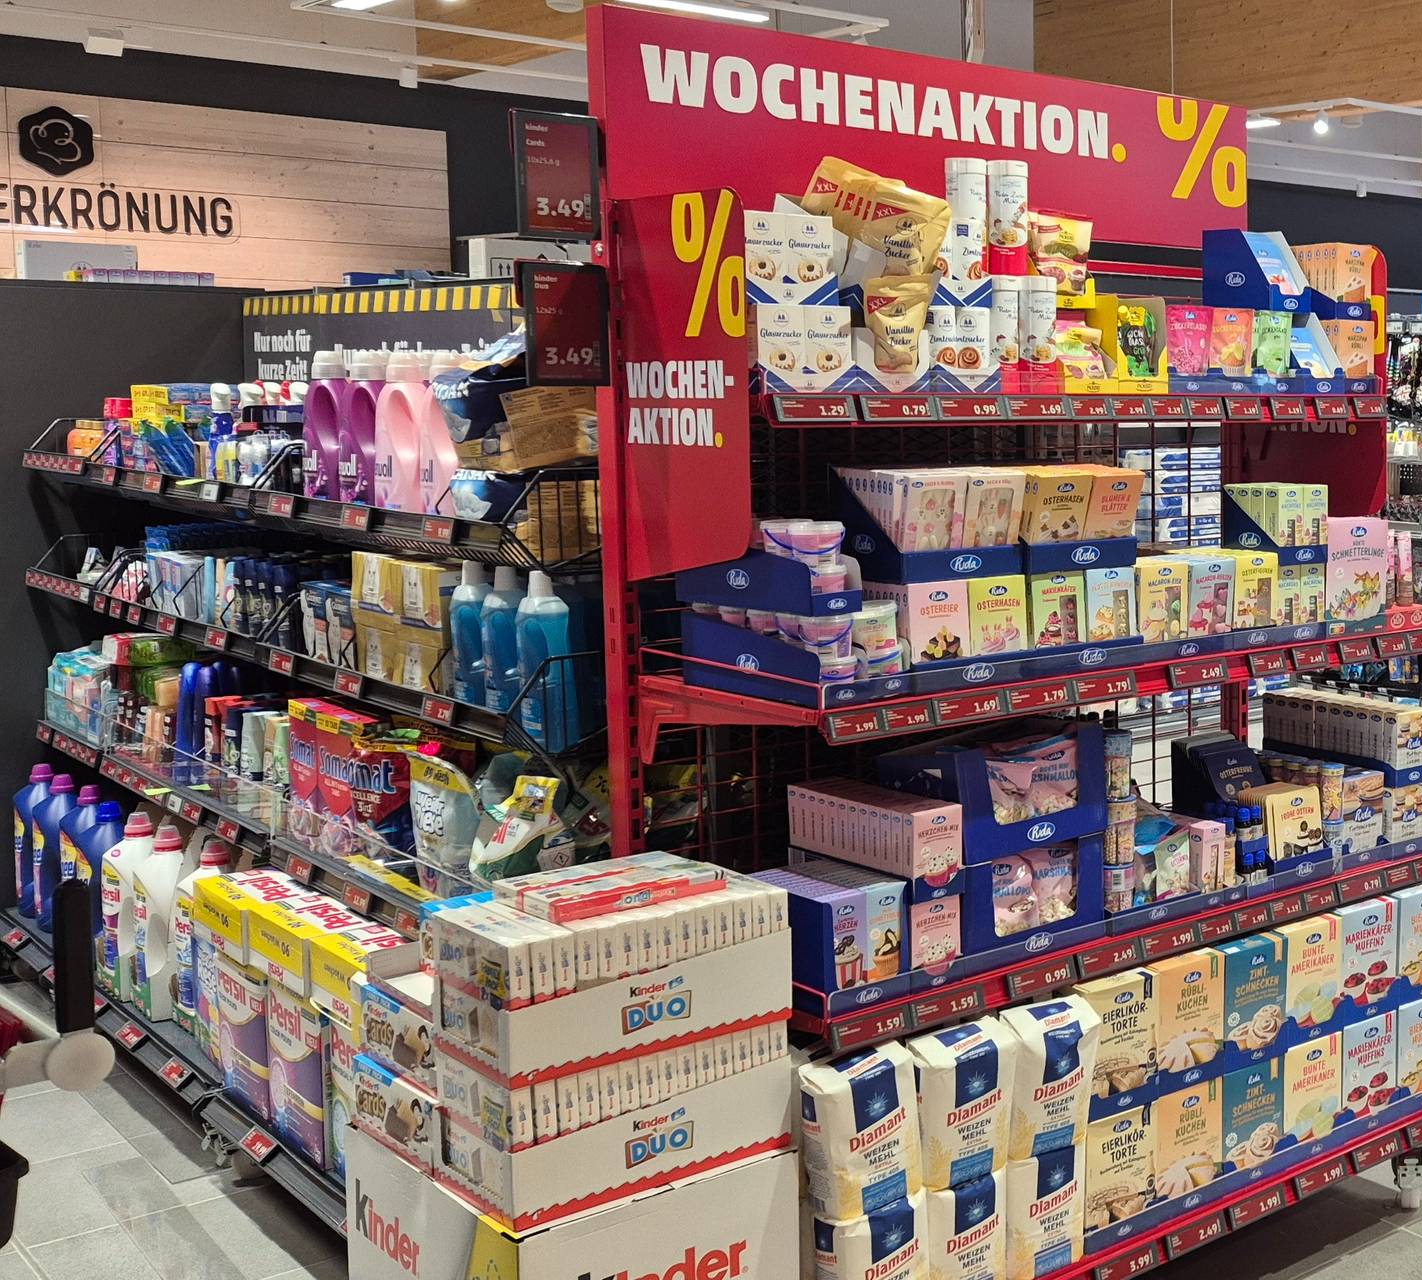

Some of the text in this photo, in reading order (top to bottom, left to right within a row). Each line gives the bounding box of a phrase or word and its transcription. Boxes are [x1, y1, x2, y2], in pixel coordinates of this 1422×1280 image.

[640, 43, 1248, 208] WOCHENAKTION. %
[816, 181, 837, 193] XXL
[536, 197, 584, 217] 3.49
[876, 205, 896, 216] XXL
[788, 239, 832, 250] Glasurzucker
[671, 188, 746, 338] %
[868, 298, 888, 309] XXL
[760, 328, 802, 339] Glasurzucker
[807, 329, 849, 340] Glasurzucker
[885, 324, 915, 336] Vanillin
[254, 331, 270, 352] Nur
[271, 329, 294, 352] noch
[295, 328, 312, 352] für
[545, 346, 594, 366] 3.49
[258, 355, 308, 382] kurze Zeit!
[626, 359, 735, 399] WOCHEN-
[820, 405, 844, 416] 1.29
[902, 405, 926, 416] 0.79
[973, 404, 996, 415] 0.99
[1040, 404, 1061, 415] 1.69
[627, 407, 724, 448] AKTION.
[1331, 548, 1385, 561] SCHMETTERLINGE
[920, 604, 960, 616] OSTEREIER
[976, 598, 1021, 611] OSTERHASEN
[1202, 667, 1221, 679] 2.49
[1107, 680, 1127, 693] 1.79
[1043, 689, 1064, 702] 1.79
[974, 700, 996, 713] 1.69
[907, 713, 924, 724] 1.99
[855, 722, 874, 732] 1.99
[319, 746, 350, 783] Soma
[1364, 879, 1378, 891] 0.79
[1172, 933, 1191, 946] 1.99
[1355, 936, 1385, 951] MUFFINS
[1113, 948, 1134, 962] 2.49
[1302, 944, 1326, 960] BUNTE
[1291, 953, 1336, 976] AMERIKANER
[1044, 967, 1066, 984] 0.99
[1180, 983, 1207, 999] RÜBLI-
[1234, 975, 1280, 998] SCHNECKEN
[950, 996, 974, 1010] 1.59
[1176, 995, 1209, 1012] KUCHEN
[269, 988, 302, 1041] Persil
[626, 995, 688, 1031] DUO
[1102, 1001, 1149, 1026] EIERLIKÖR-
[876, 1018, 900, 1033] 1.59
[1110, 1016, 1138, 1031] TORTE
[331, 1025, 357, 1068] Per
[1356, 1048, 1385, 1065] MUFFINS
[1303, 1060, 1327, 1077] BUNTE
[1033, 1066, 1085, 1102] Diamant
[1292, 1069, 1336, 1094] AMERIKANER
[355, 1084, 387, 1122] Cards
[946, 1088, 1002, 1127] Diamant
[1043, 1094, 1075, 1111] WEIZEN
[1047, 1104, 1071, 1117] MEHL
[1232, 1095, 1277, 1116] SCHNECKEN
[1179, 1109, 1205, 1124] RÜBLI-
[849, 1107, 907, 1153] Diamant
[957, 1117, 992, 1136] WEIZEN
[1175, 1120, 1208, 1139] KUCHEN
[961, 1128, 987, 1142] MEHL
[1101, 1129, 1147, 1154] EIERLIKÖR-
[630, 1125, 690, 1164] DUO
[863, 1139, 900, 1160] WEIZEN
[1110, 1144, 1138, 1158] TORTE
[1380, 1141, 1396, 1156] 1.99
[869, 1150, 896, 1166] MEHL
[1323, 1167, 1341, 1182] 1.99
[1029, 1180, 1079, 1218] Diamant
[1259, 1197, 1278, 1213] 1.99
[1039, 1209, 1070, 1227] WEIZEN
[946, 1214, 1000, 1254] Diamant
[1043, 1220, 1067, 1234] MEHL
[1199, 1224, 1218, 1240] 2.49
[864, 1238, 920, 1280] Diamant
[957, 1243, 991, 1263] WEIZEN
[961, 1255, 987, 1269] MEHL
[1129, 1255, 1150, 1272] 3.99
